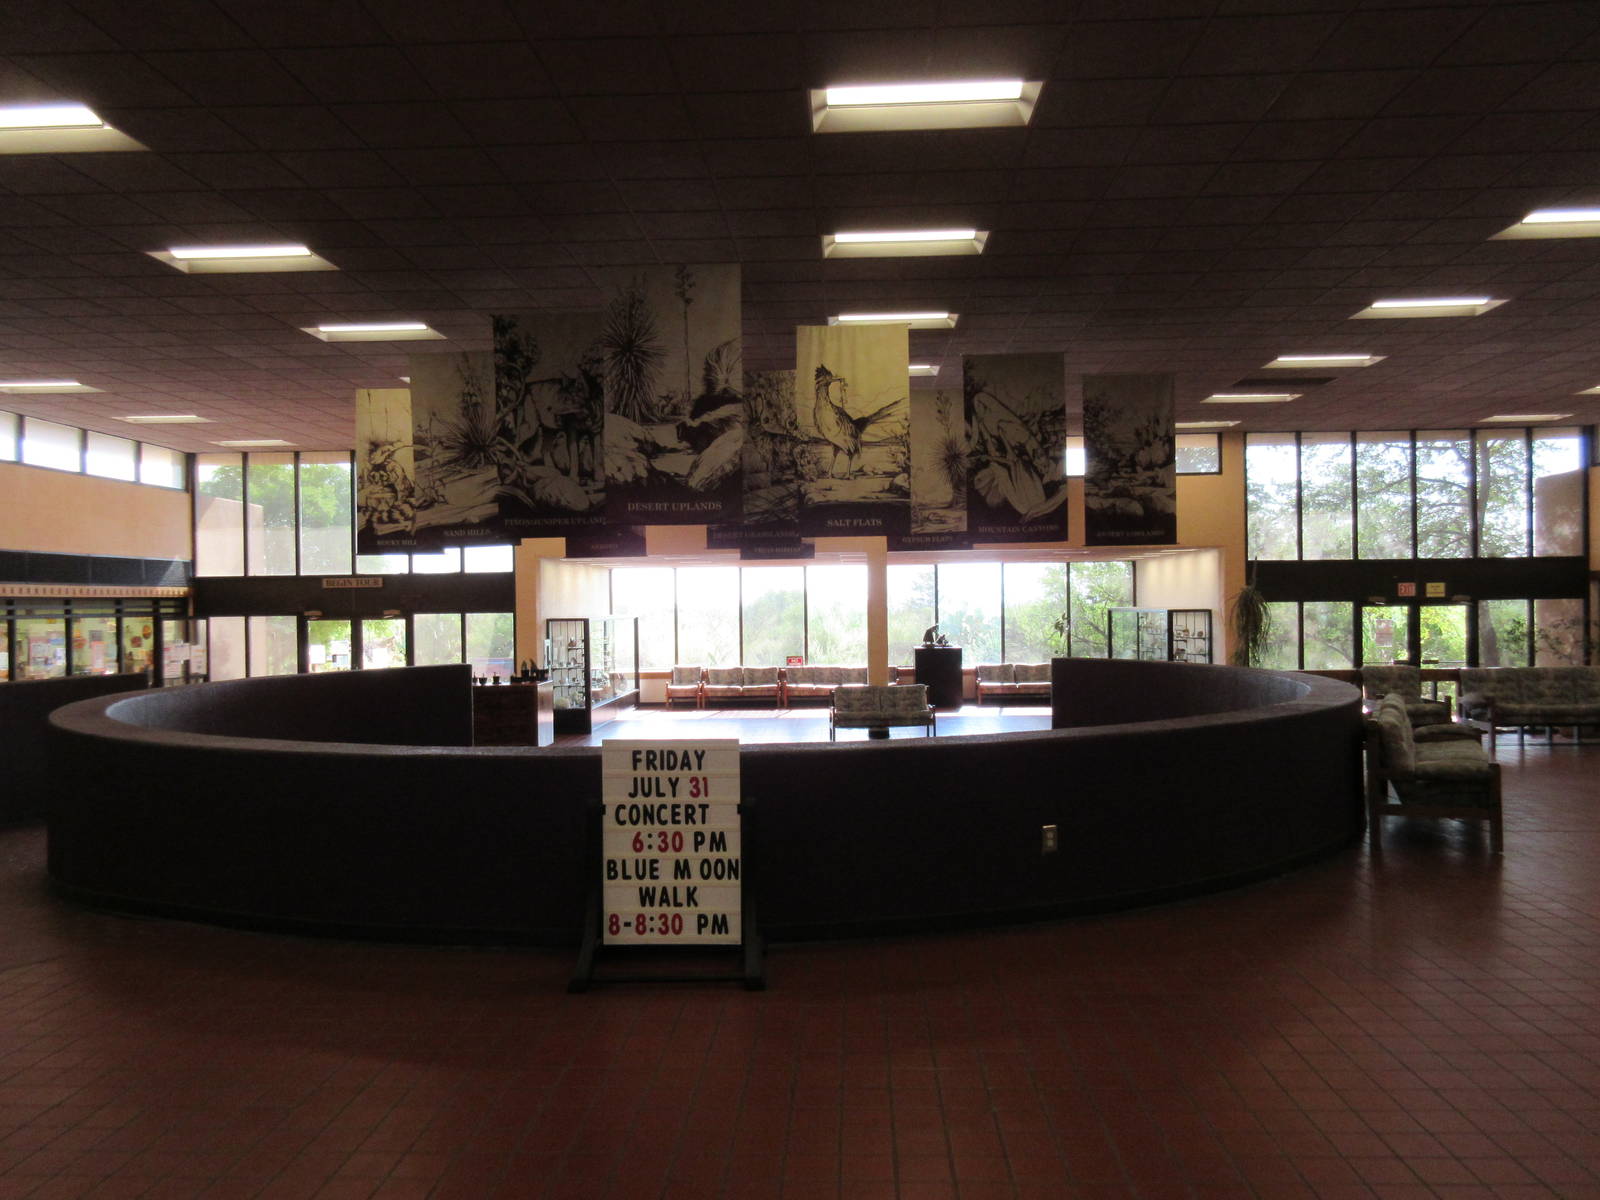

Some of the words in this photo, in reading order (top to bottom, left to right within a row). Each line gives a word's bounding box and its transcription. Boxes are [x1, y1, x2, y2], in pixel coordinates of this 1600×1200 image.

[627, 502, 670, 512] DESERT
[671, 501, 722, 511] UPLANDS
[826, 519, 850, 527] SALT
[852, 518, 883, 527] FLATS
[326, 578, 352, 587] BEGIN
[355, 578, 381, 586] TOUR
[631, 749, 706, 772] FRIDAY
[628, 776, 680, 799] JULY
[688, 776, 709, 798] 31
[614, 803, 710, 826] CONCERT
[631, 831, 684, 853] 6:30
[693, 831, 728, 853] PM
[606, 859, 660, 881] BLUE
[638, 886, 699, 908] WALK
[608, 913, 684, 936] 8-8:30
[696, 913, 730, 936] PM
